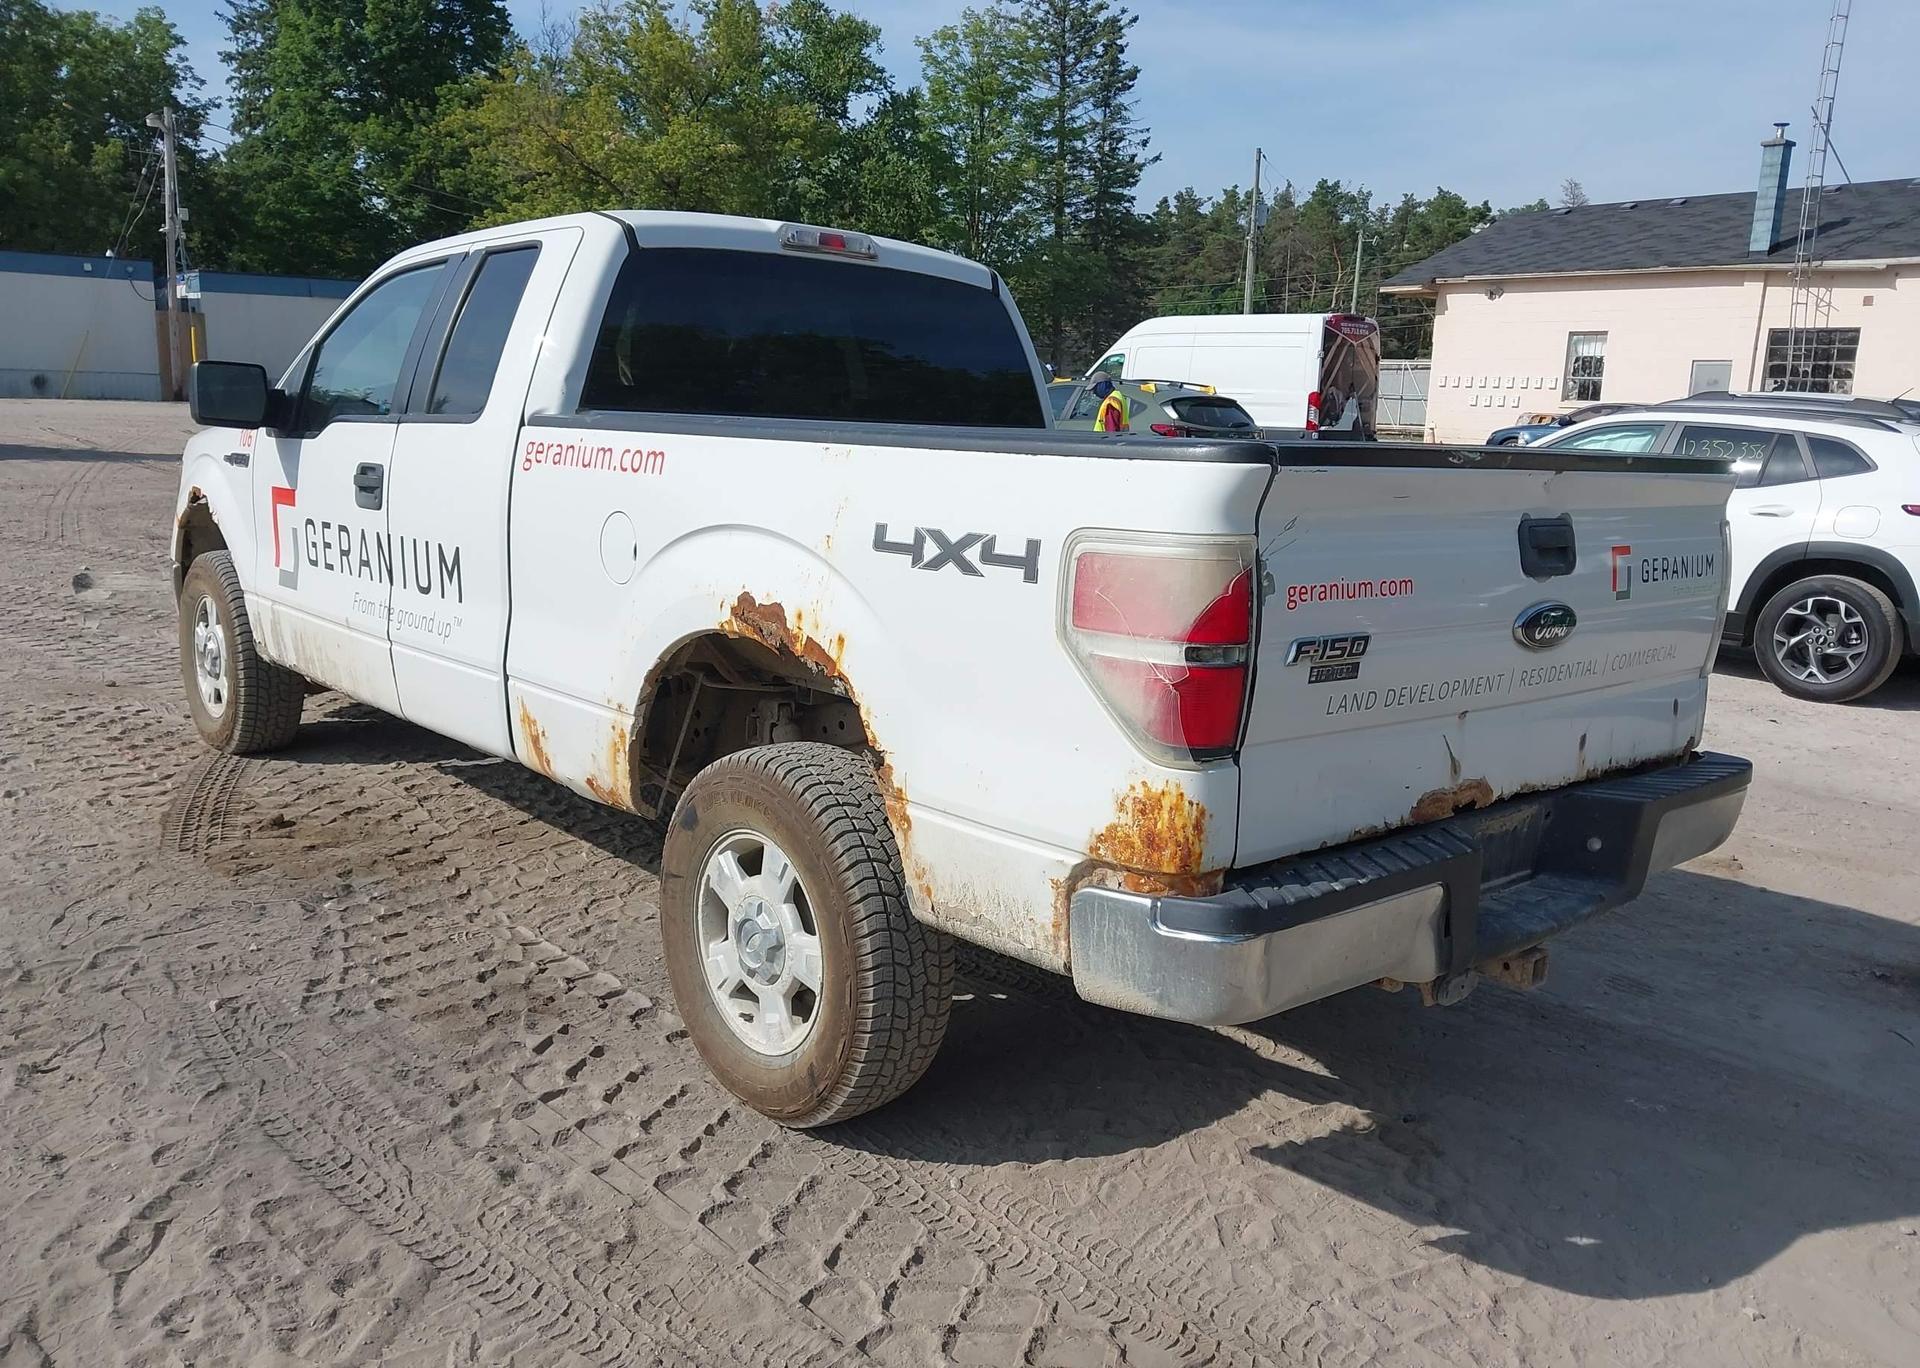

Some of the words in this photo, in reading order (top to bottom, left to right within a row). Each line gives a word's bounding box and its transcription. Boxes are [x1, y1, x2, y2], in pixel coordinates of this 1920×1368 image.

[522, 438, 666, 476] geranium.com
[304, 517, 463, 604] GERANIUM
[1641, 553, 1714, 583] GERANIUM
[352, 591, 376, 617] From
[378, 599, 395, 622] the
[396, 608, 436, 633] ground
[1286, 577, 1413, 610] geranium.com
[1326, 690, 1378, 715] LAND
[1384, 673, 1505, 708] DEVELOPMENT
[1519, 658, 1599, 688] RESIDENTIAL
[1611, 643, 1678, 672] COMMERCIAL
